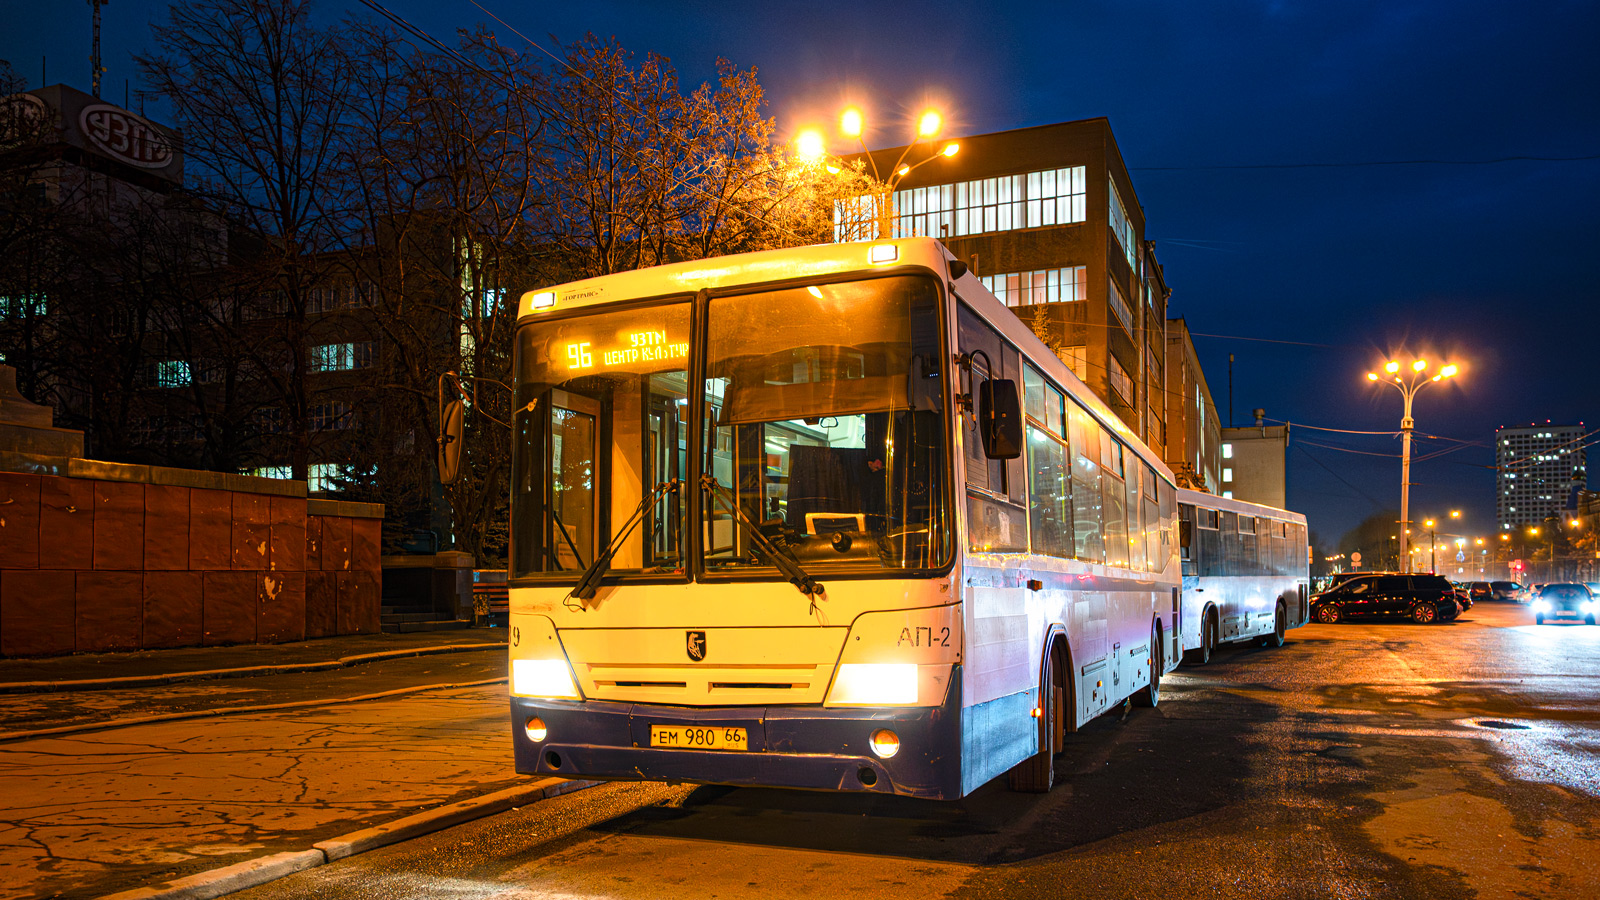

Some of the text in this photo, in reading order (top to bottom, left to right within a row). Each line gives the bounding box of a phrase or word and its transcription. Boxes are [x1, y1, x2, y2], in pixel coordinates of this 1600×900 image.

[89, 111, 168, 161] УЗТМ
[630, 330, 666, 347] УЗТМ
[567, 342, 592, 369] 96
[604, 348, 639, 365] ЦЕНТР
[897, 627, 950, 647] АП-2
[685, 728, 715, 746] 980
[725, 728, 741, 742] 66
